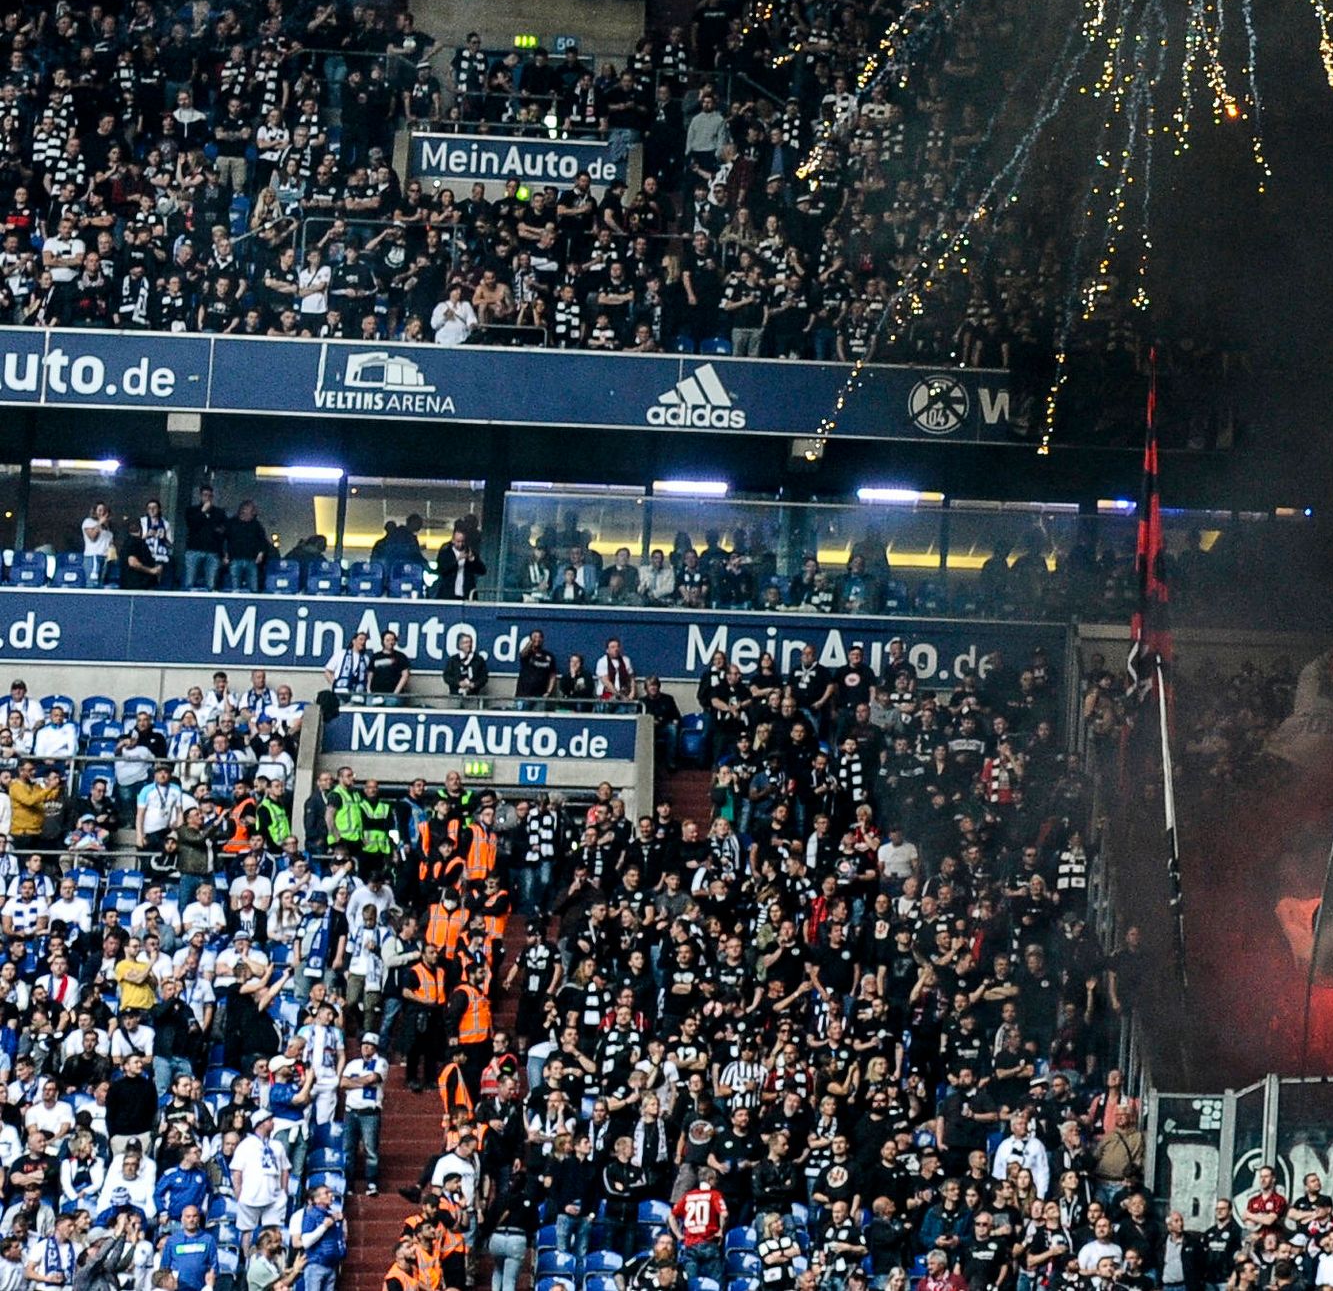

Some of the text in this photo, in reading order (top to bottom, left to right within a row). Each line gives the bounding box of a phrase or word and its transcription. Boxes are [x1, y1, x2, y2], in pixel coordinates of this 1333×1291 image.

[421, 140, 617, 181] MeinAutode
[0, 348, 175, 397] uto.de
[314, 390, 456, 414] VELTINS ARENA
[646, 403, 746, 429] adidas
[351, 713, 608, 759] MeinAuto.de
[525, 766, 539, 782] U
[684, 1200, 710, 1227] 20
